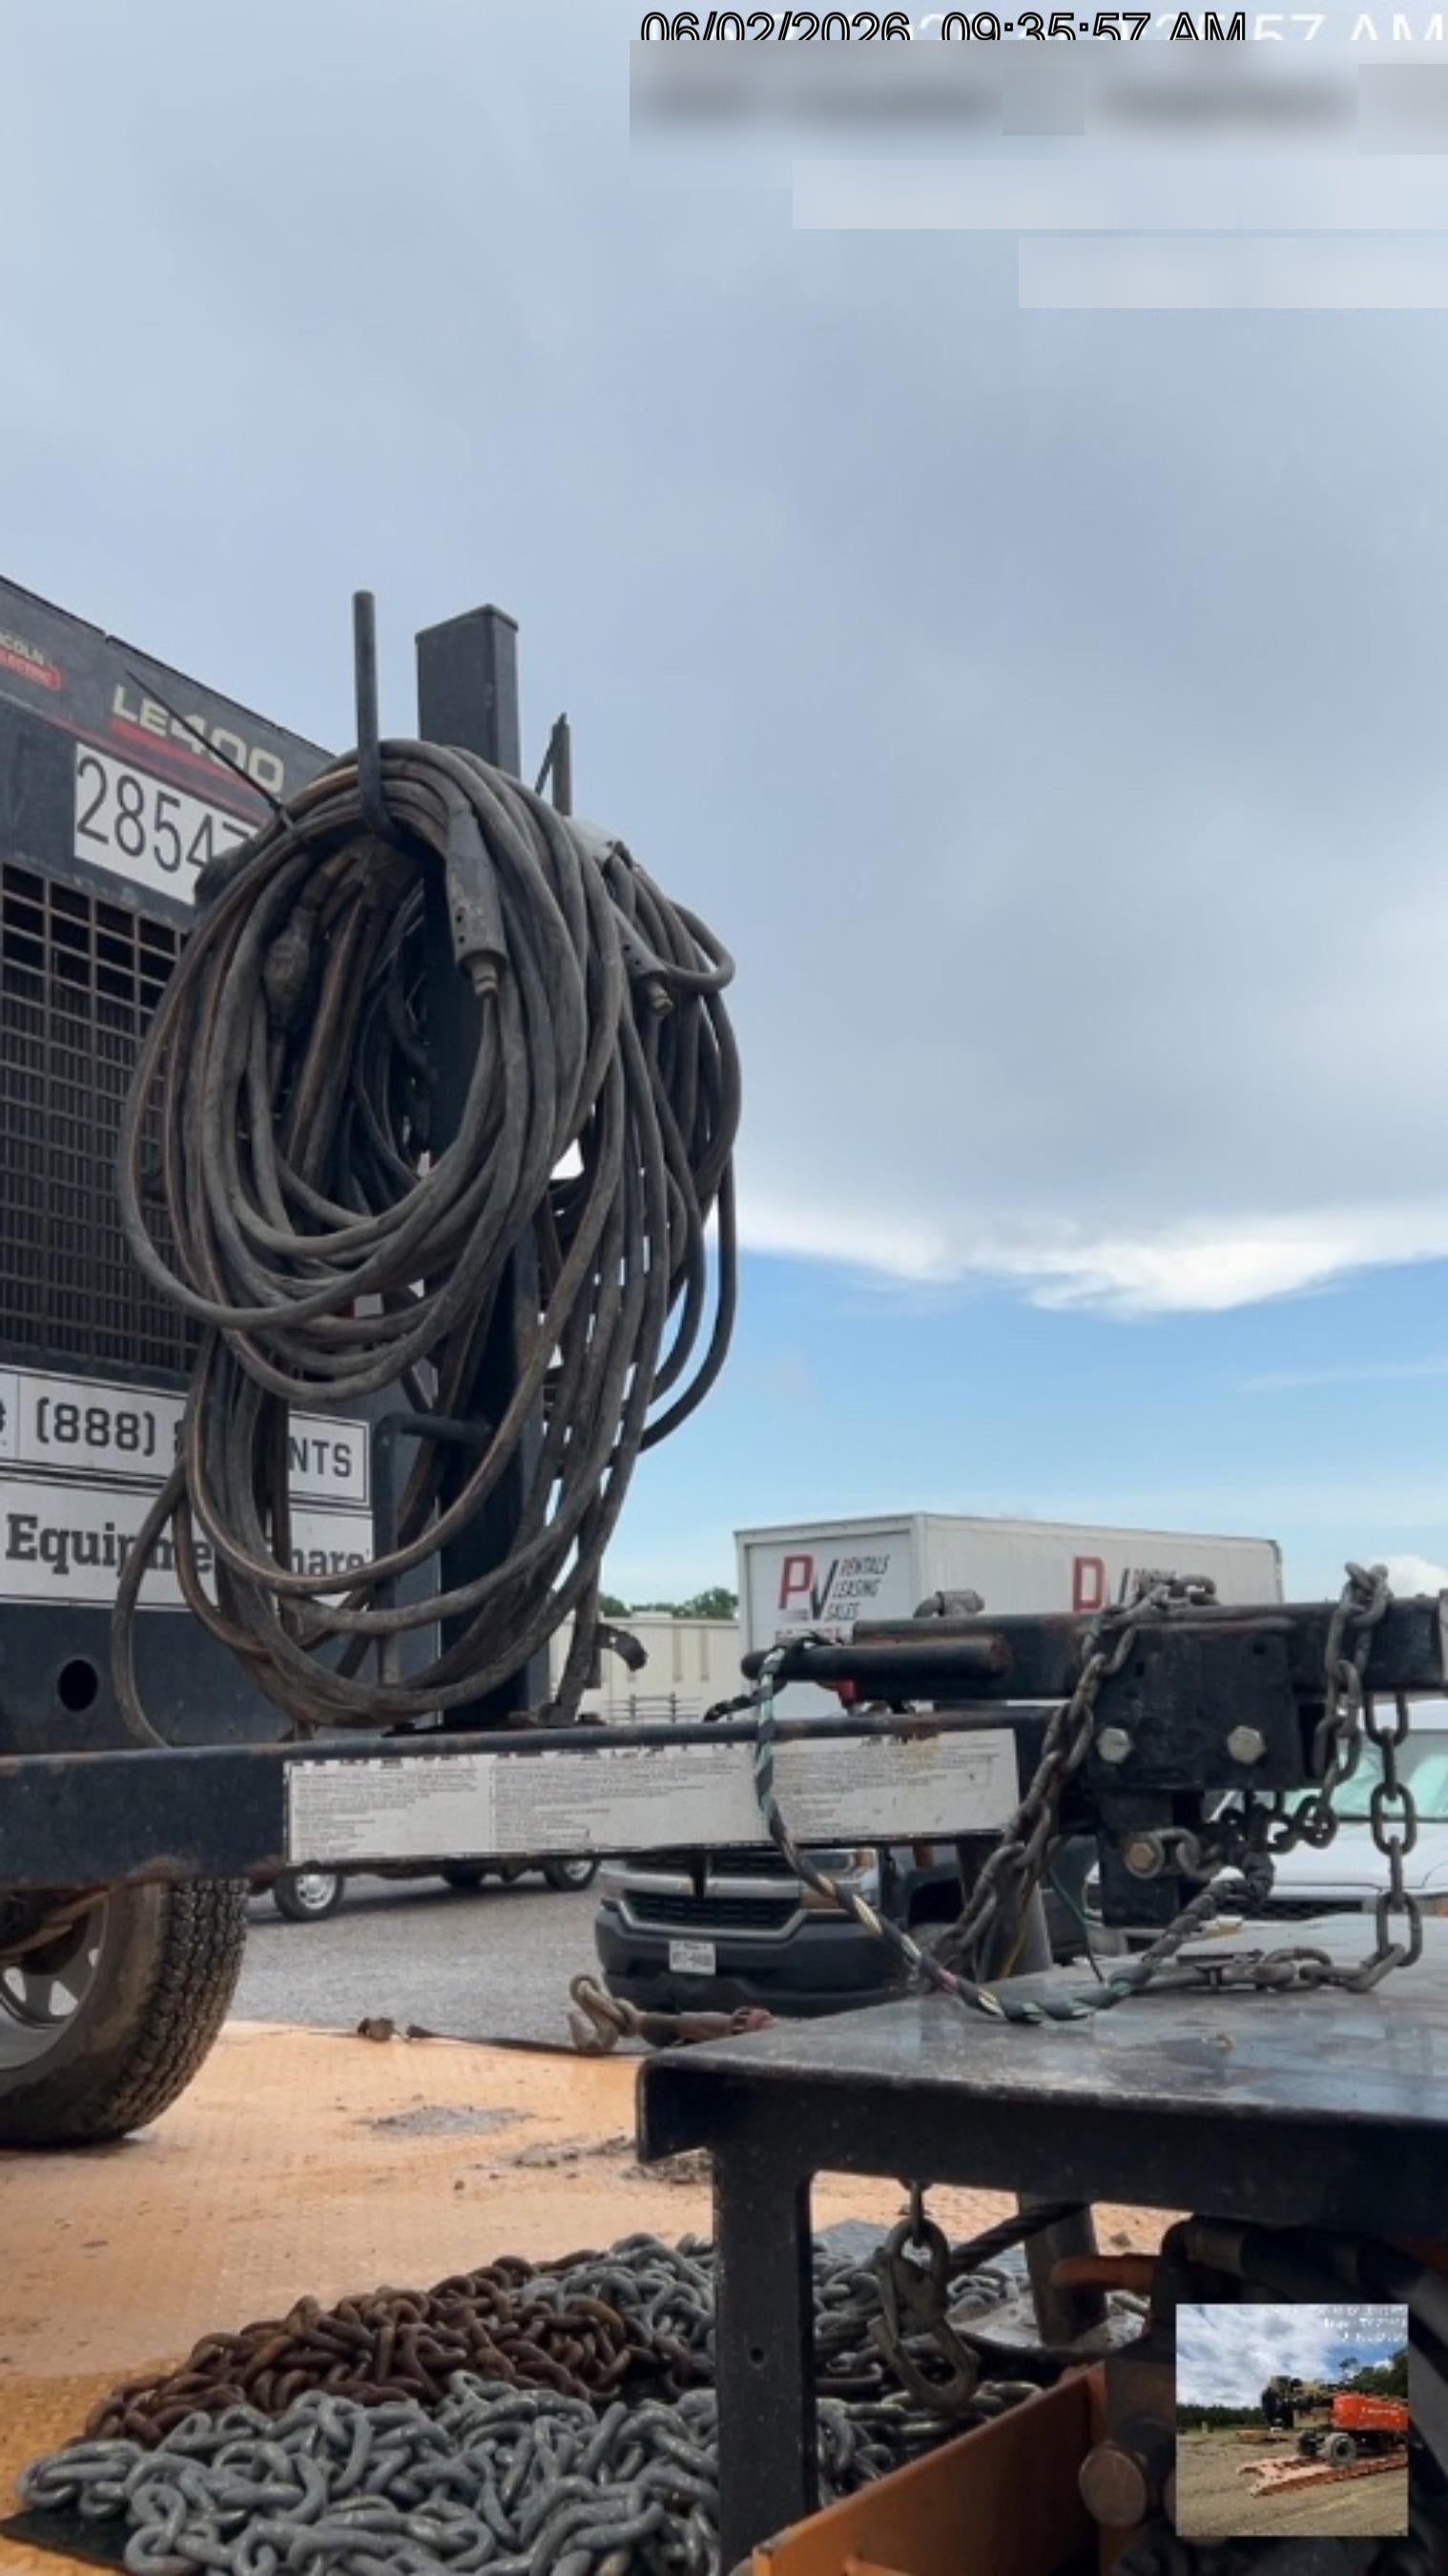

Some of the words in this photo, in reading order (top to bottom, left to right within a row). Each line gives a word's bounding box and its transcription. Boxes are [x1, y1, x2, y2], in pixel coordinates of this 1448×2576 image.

[113, 684, 284, 793] LE400
[37, 1397, 155, 1457] (888)
[832, 1578, 882, 1598] LEASING
